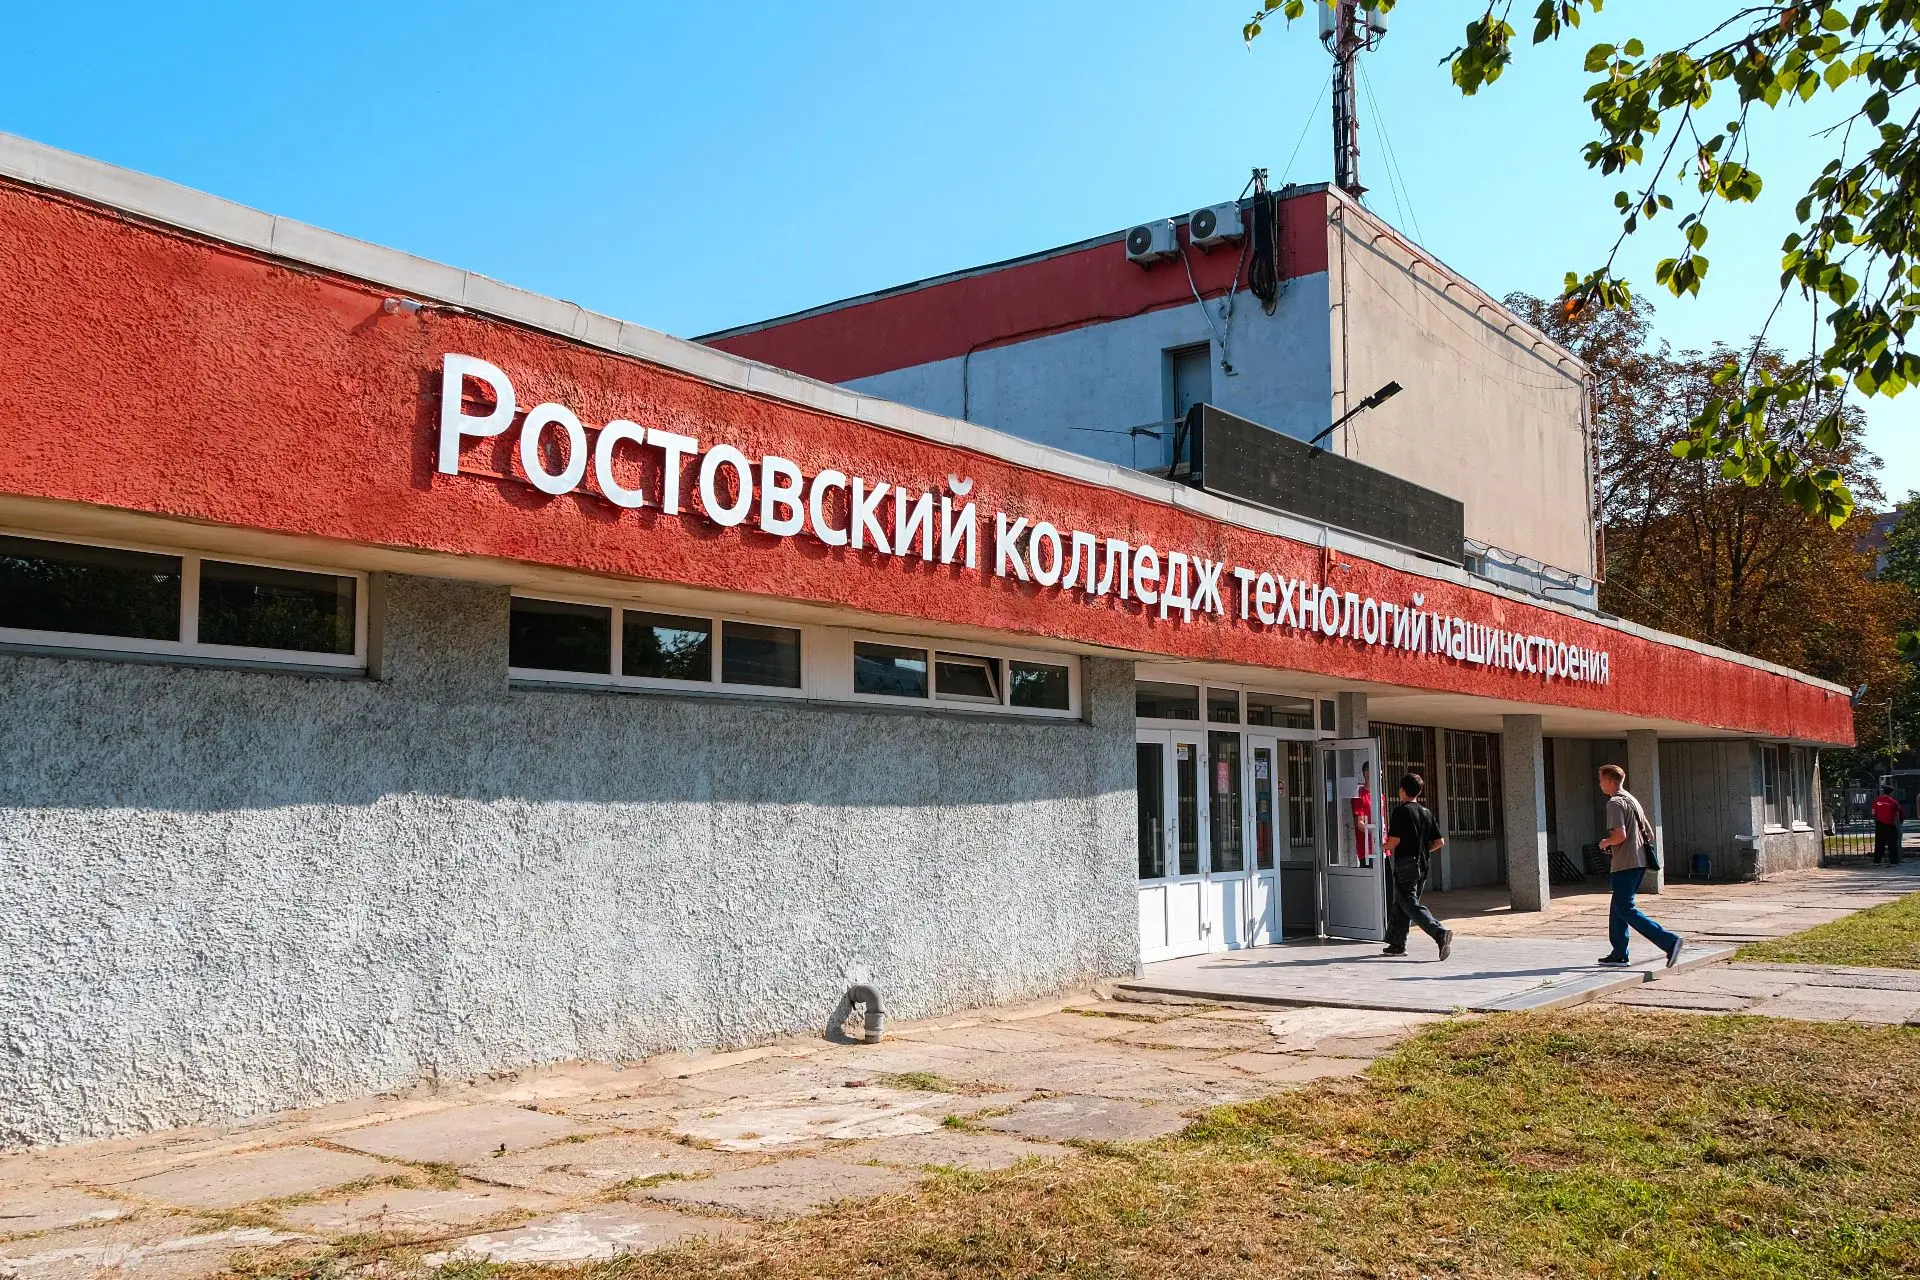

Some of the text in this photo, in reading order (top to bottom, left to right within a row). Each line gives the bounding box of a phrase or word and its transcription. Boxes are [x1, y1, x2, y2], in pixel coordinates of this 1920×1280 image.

[437, 353, 1609, 685] Ростовский колледж технологий машиностроения
